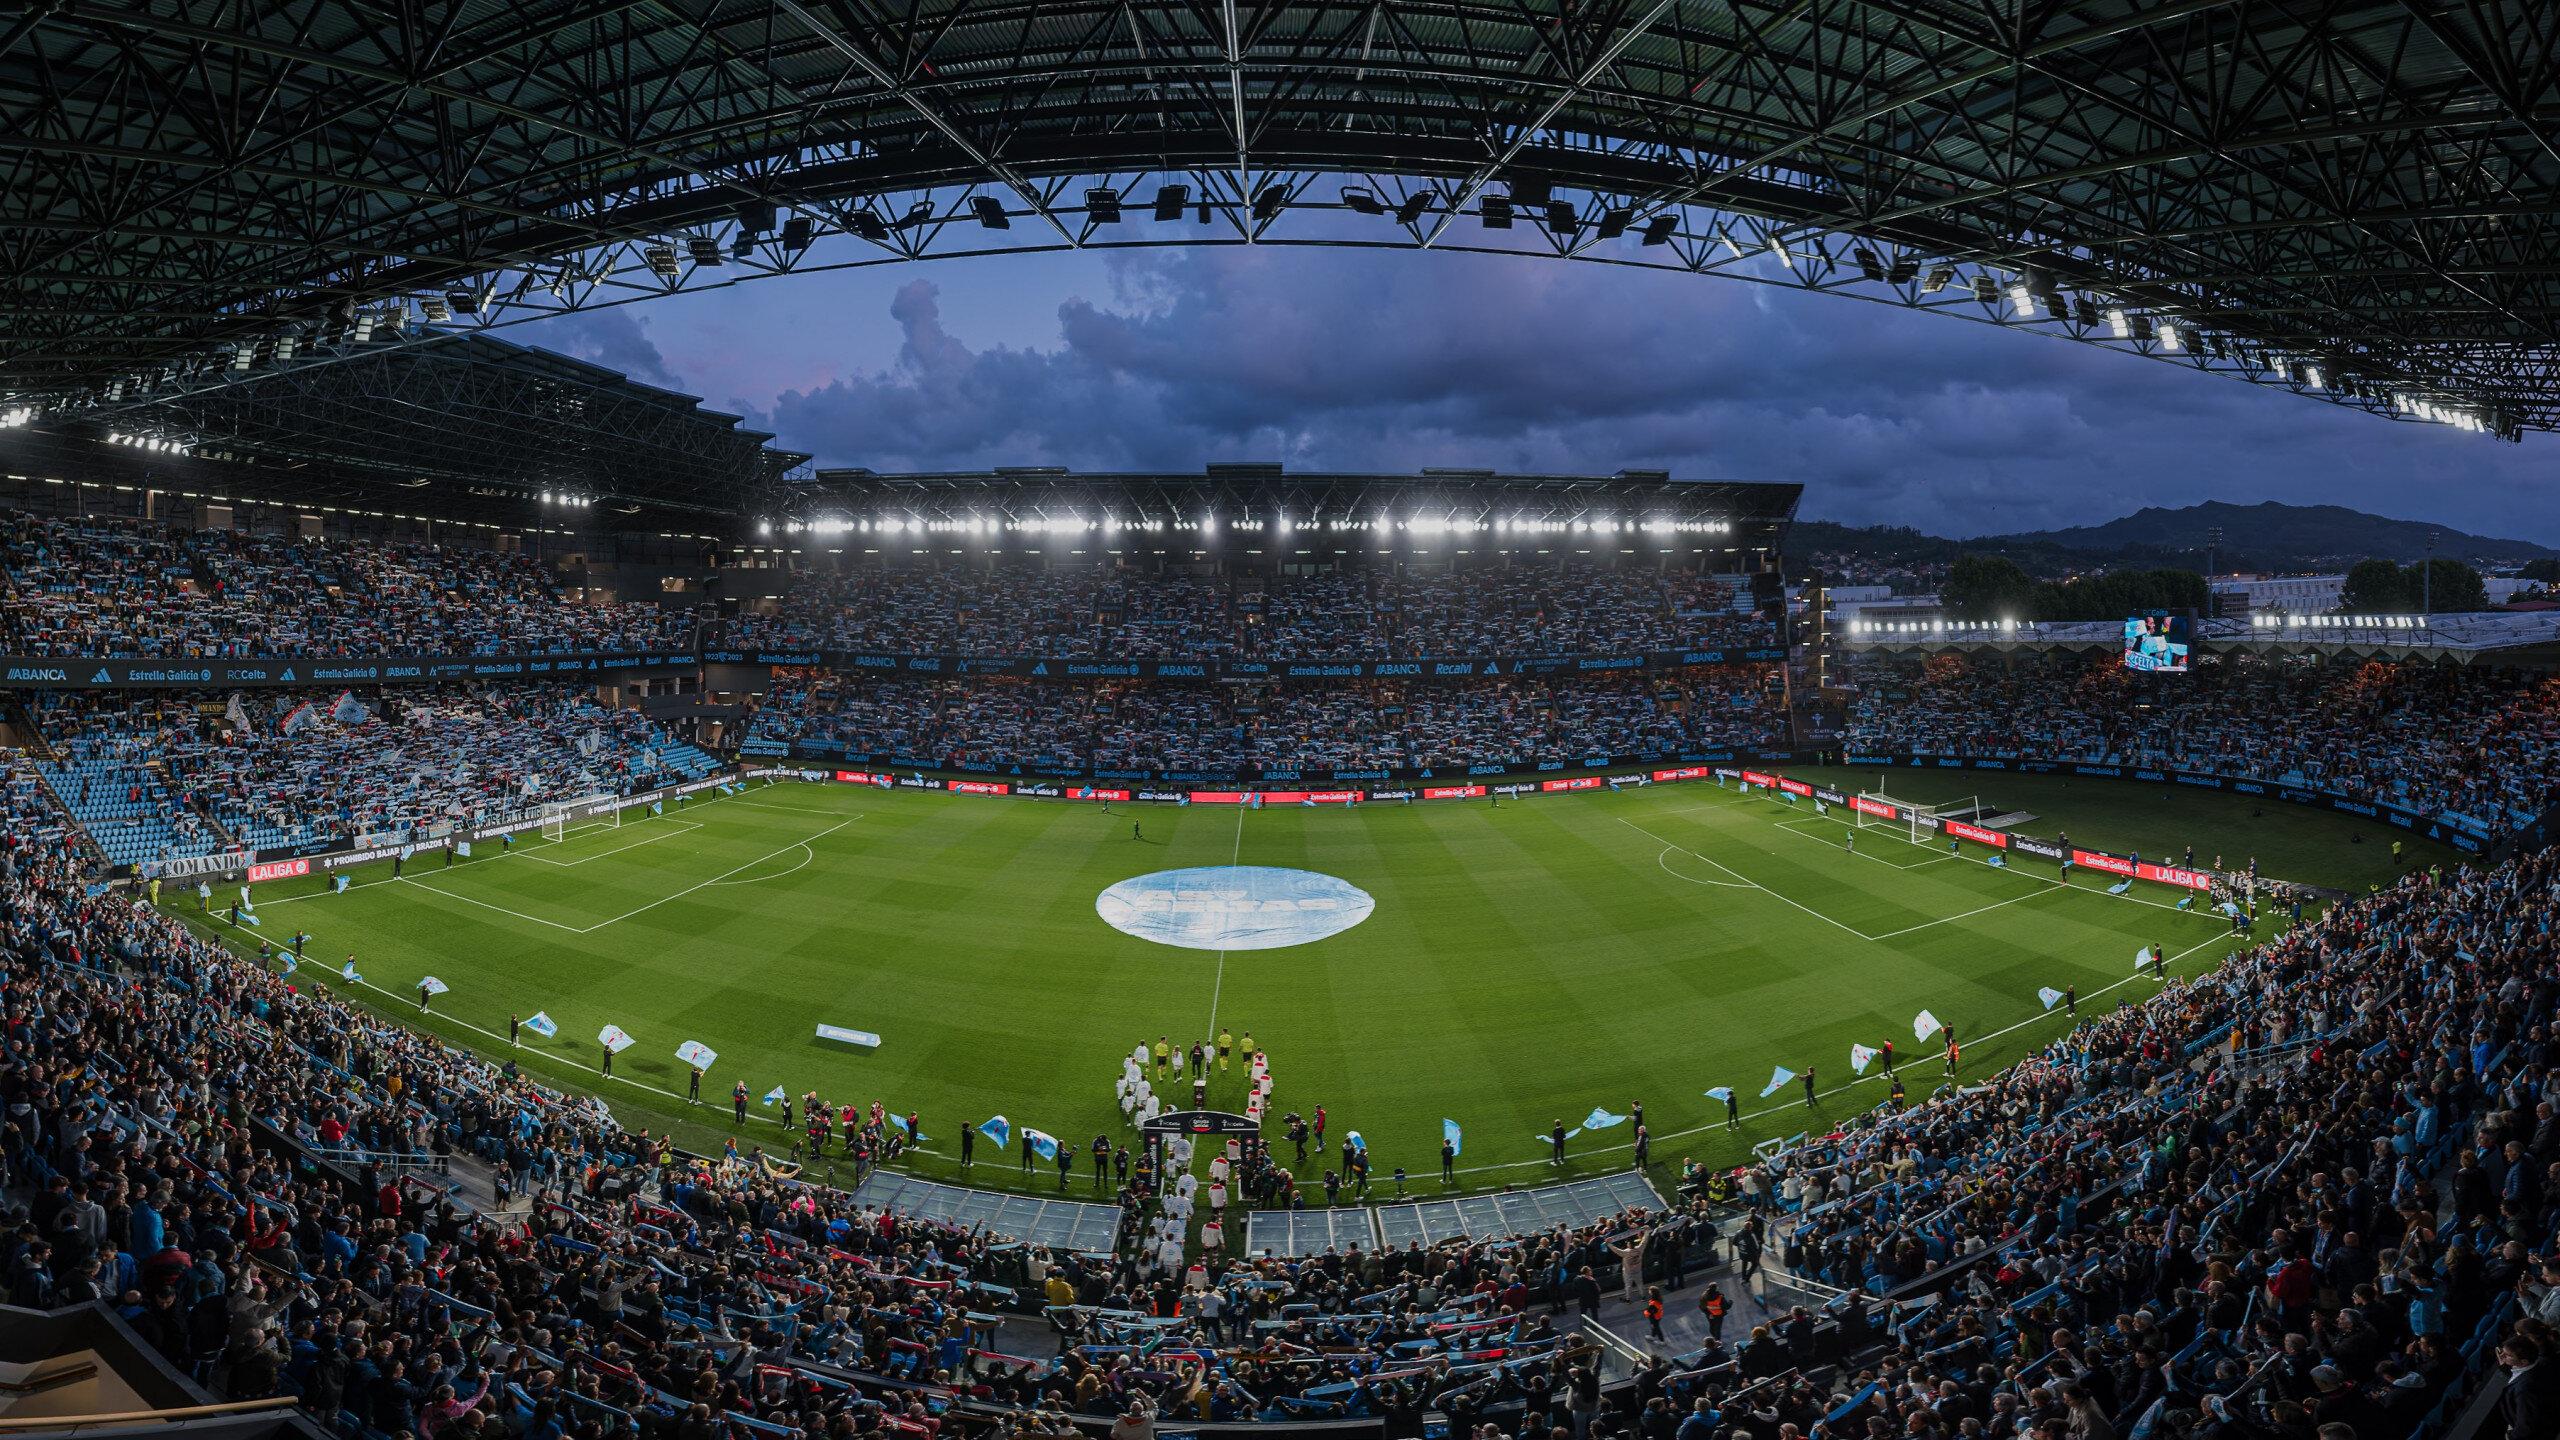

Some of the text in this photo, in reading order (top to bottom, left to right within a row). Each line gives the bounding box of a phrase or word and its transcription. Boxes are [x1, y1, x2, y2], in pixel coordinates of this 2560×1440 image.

[128, 668, 199, 682] Estrella Galicia
[313, 668, 368, 680] Estrella Galicia
[1067, 664, 1128, 675] Estrella Galicia
[1290, 665, 1351, 676] Estrella Galicia
[1436, 663, 1473, 674] Recalvi
[481, 825, 514, 837] PROHIBIDO
[514, 821, 533, 832] BAJAR
[1955, 825, 1990, 841] Estrella Galicia
[334, 851, 375, 866] PROHIBIDO
[376, 846, 399, 858] BAJAR
[416, 839, 443, 851] BRAZOS
[2016, 840, 2055, 857] Estrella Galicia
[253, 863, 294, 880] LALIGA
[2085, 855, 2131, 873] Estrella Galicia
[2156, 867, 2194, 886] LALIGA
